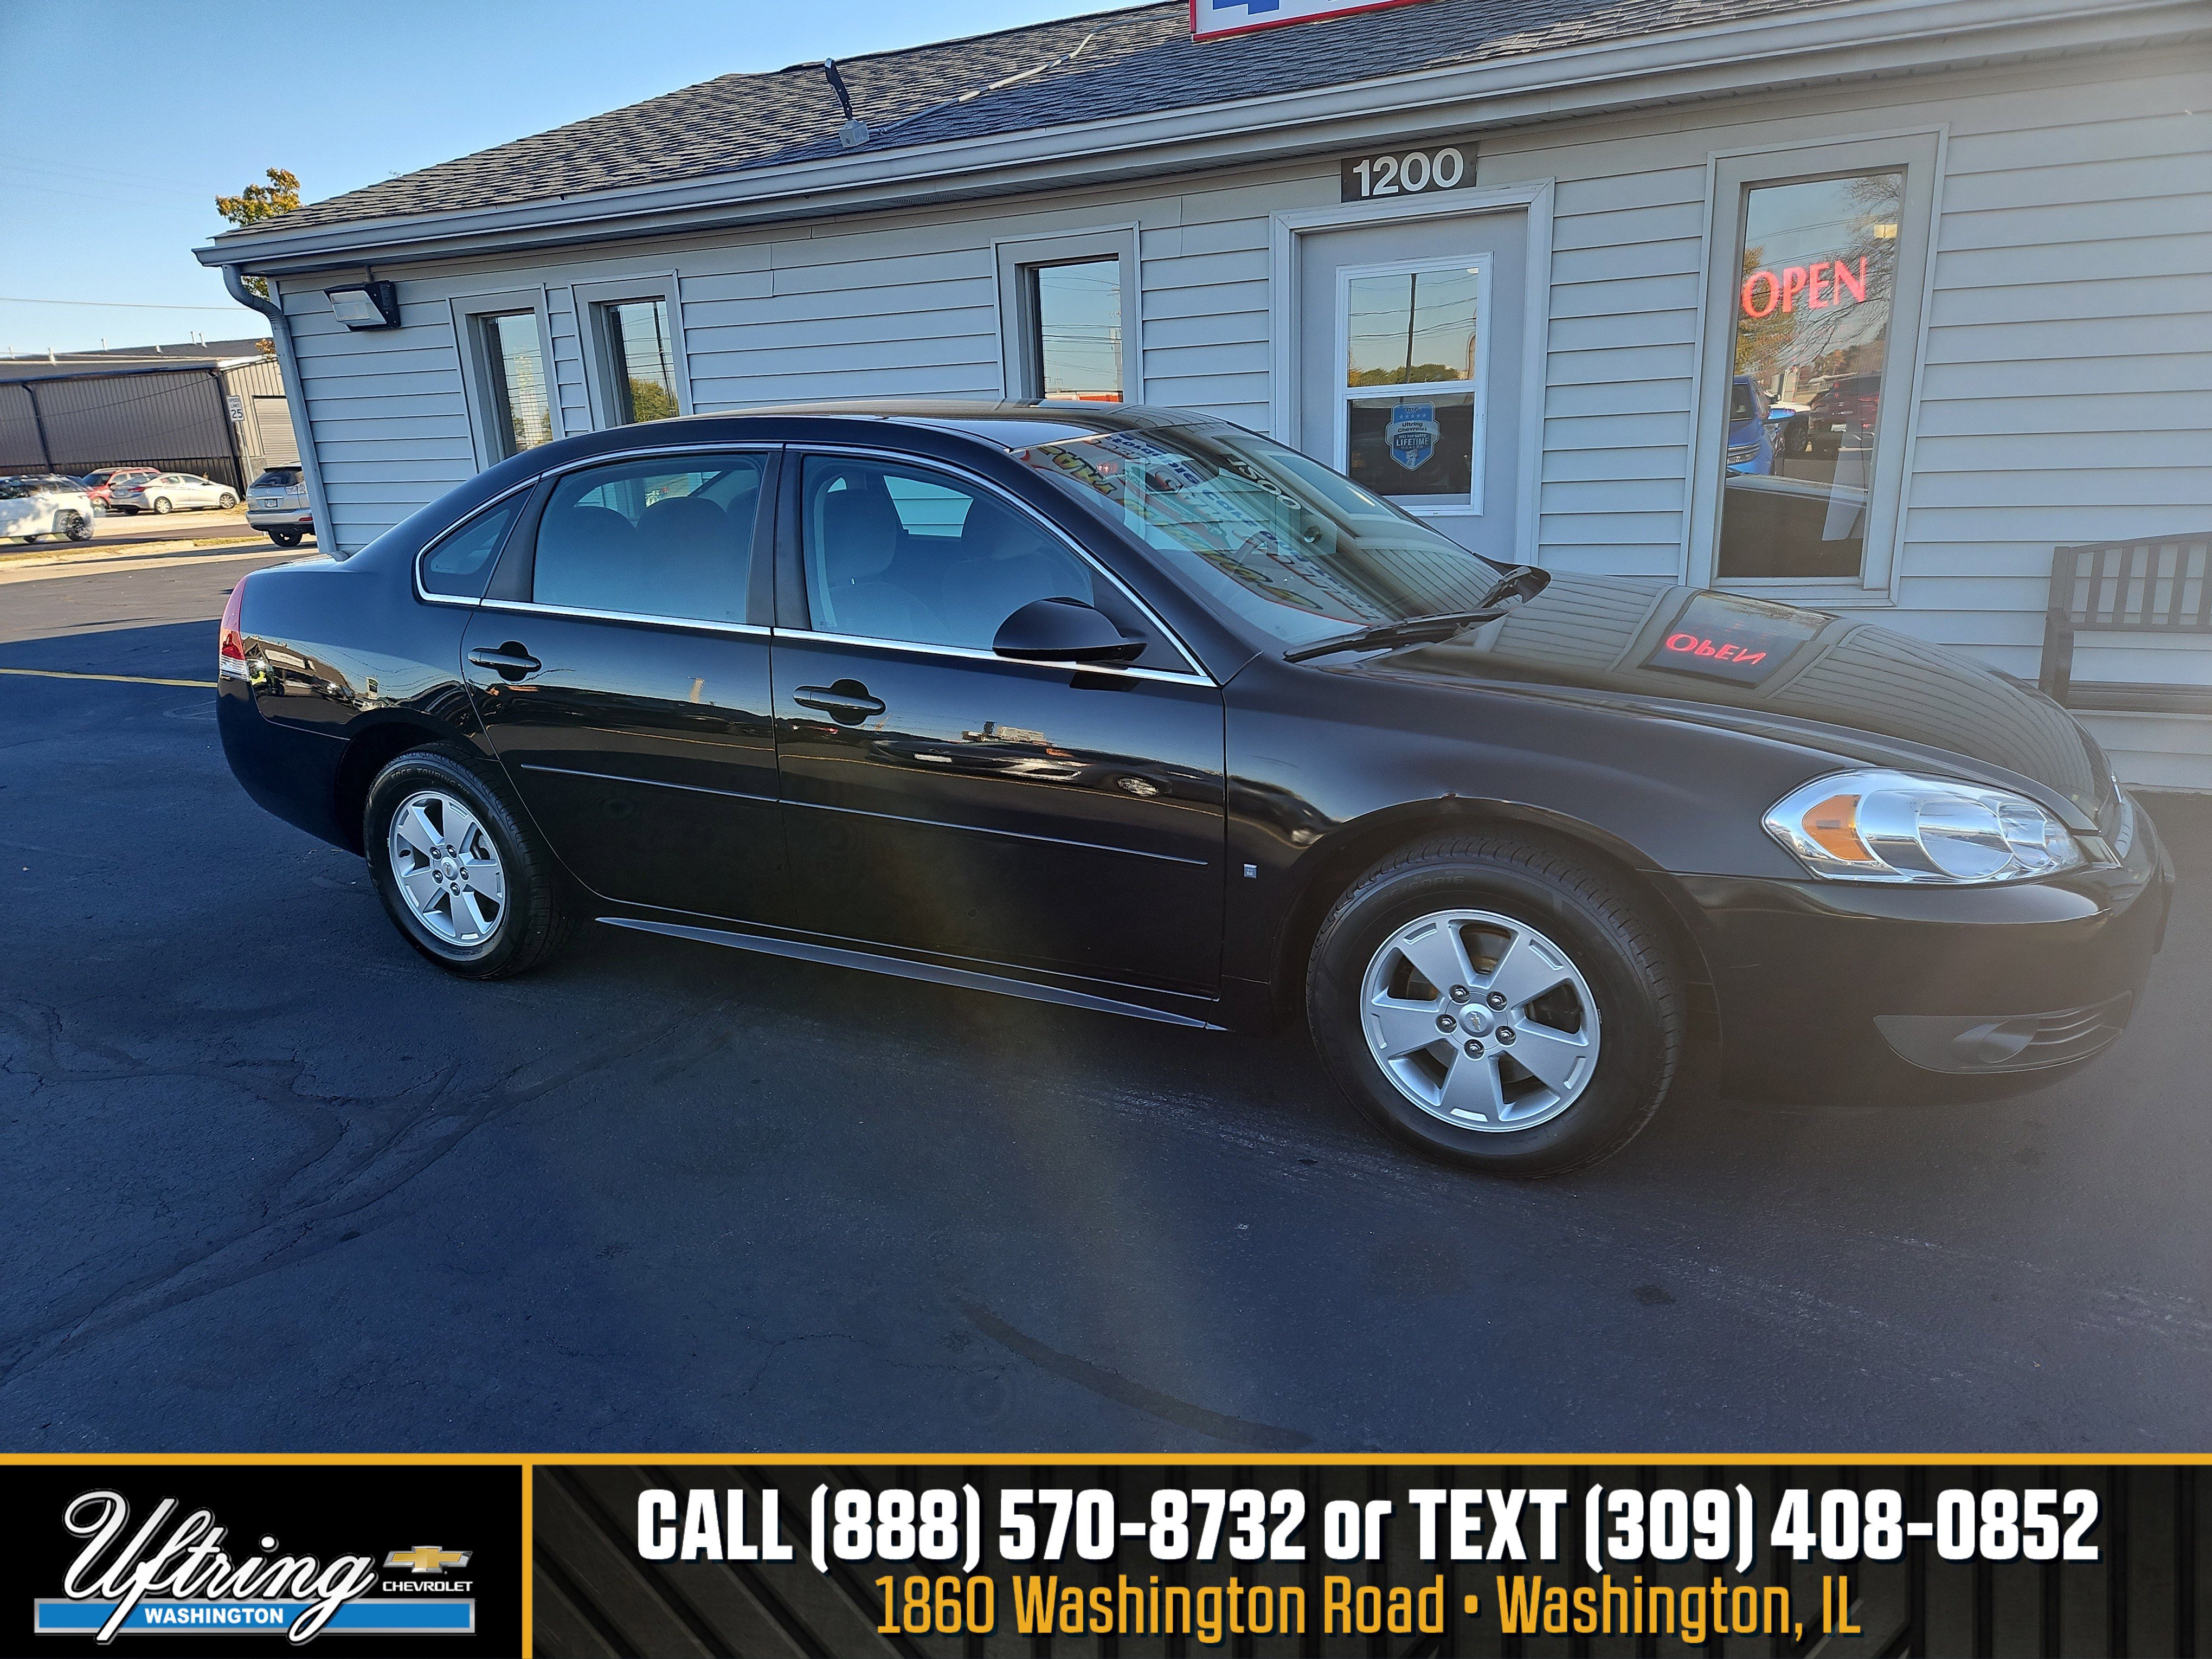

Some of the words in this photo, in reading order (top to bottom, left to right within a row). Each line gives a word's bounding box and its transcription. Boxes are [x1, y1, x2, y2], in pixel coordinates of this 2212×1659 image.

[1353, 147, 1464, 197] 1200
[1742, 256, 1867, 318] OPEN
[231, 409, 243, 418] 25
[1396, 438, 1429, 446] LIFETIME
